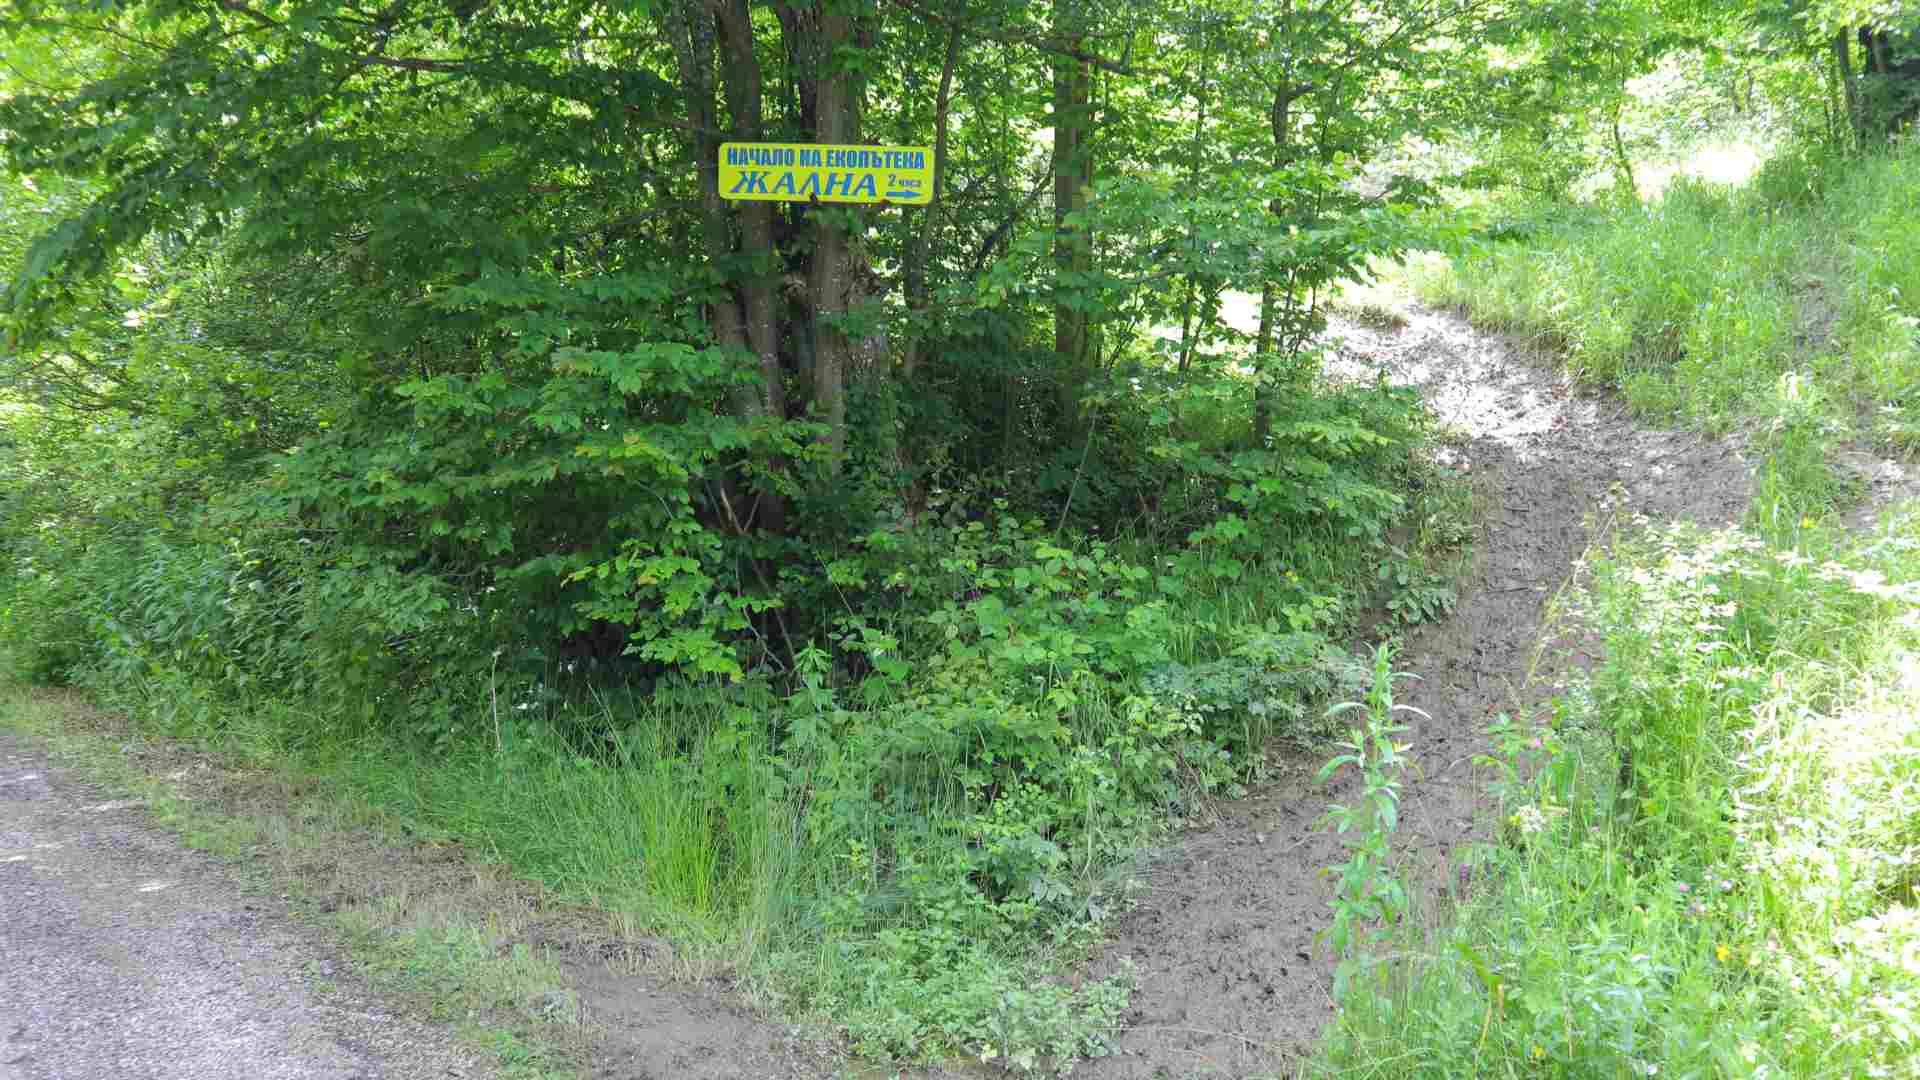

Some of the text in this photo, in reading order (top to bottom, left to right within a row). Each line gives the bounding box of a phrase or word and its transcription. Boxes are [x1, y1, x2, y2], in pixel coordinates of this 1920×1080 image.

[728, 148, 925, 169] НАЧАЛО НА ЕКОПЪТЕКА
[729, 171, 878, 197] ЖАЛНА
[888, 174, 896, 187] 2
